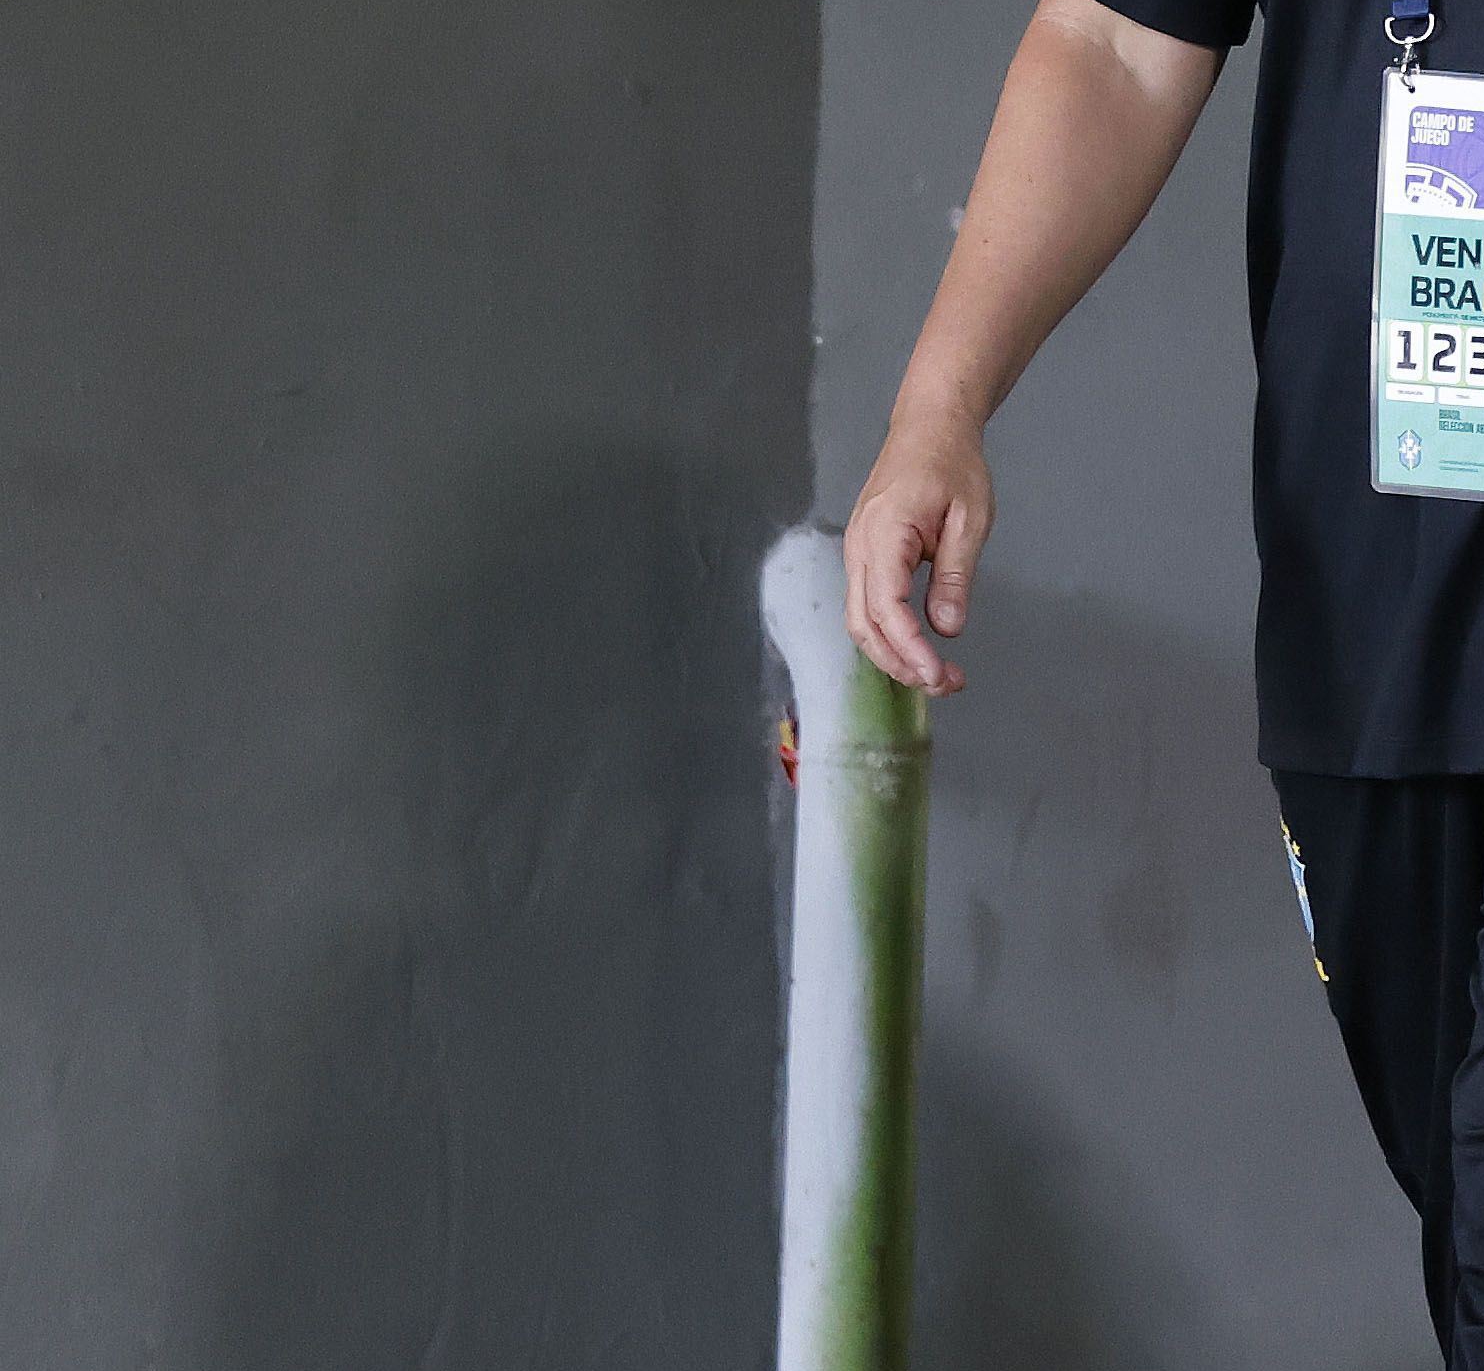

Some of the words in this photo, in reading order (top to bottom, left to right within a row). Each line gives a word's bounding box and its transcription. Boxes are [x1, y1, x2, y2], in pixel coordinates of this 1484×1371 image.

[1411, 112, 1457, 131] CAMPO
[1458, 115, 1475, 133] DE
[1410, 128, 1451, 146] JUEGO
[1411, 234, 1482, 269] VEN
[1410, 276, 1482, 312] BRA
